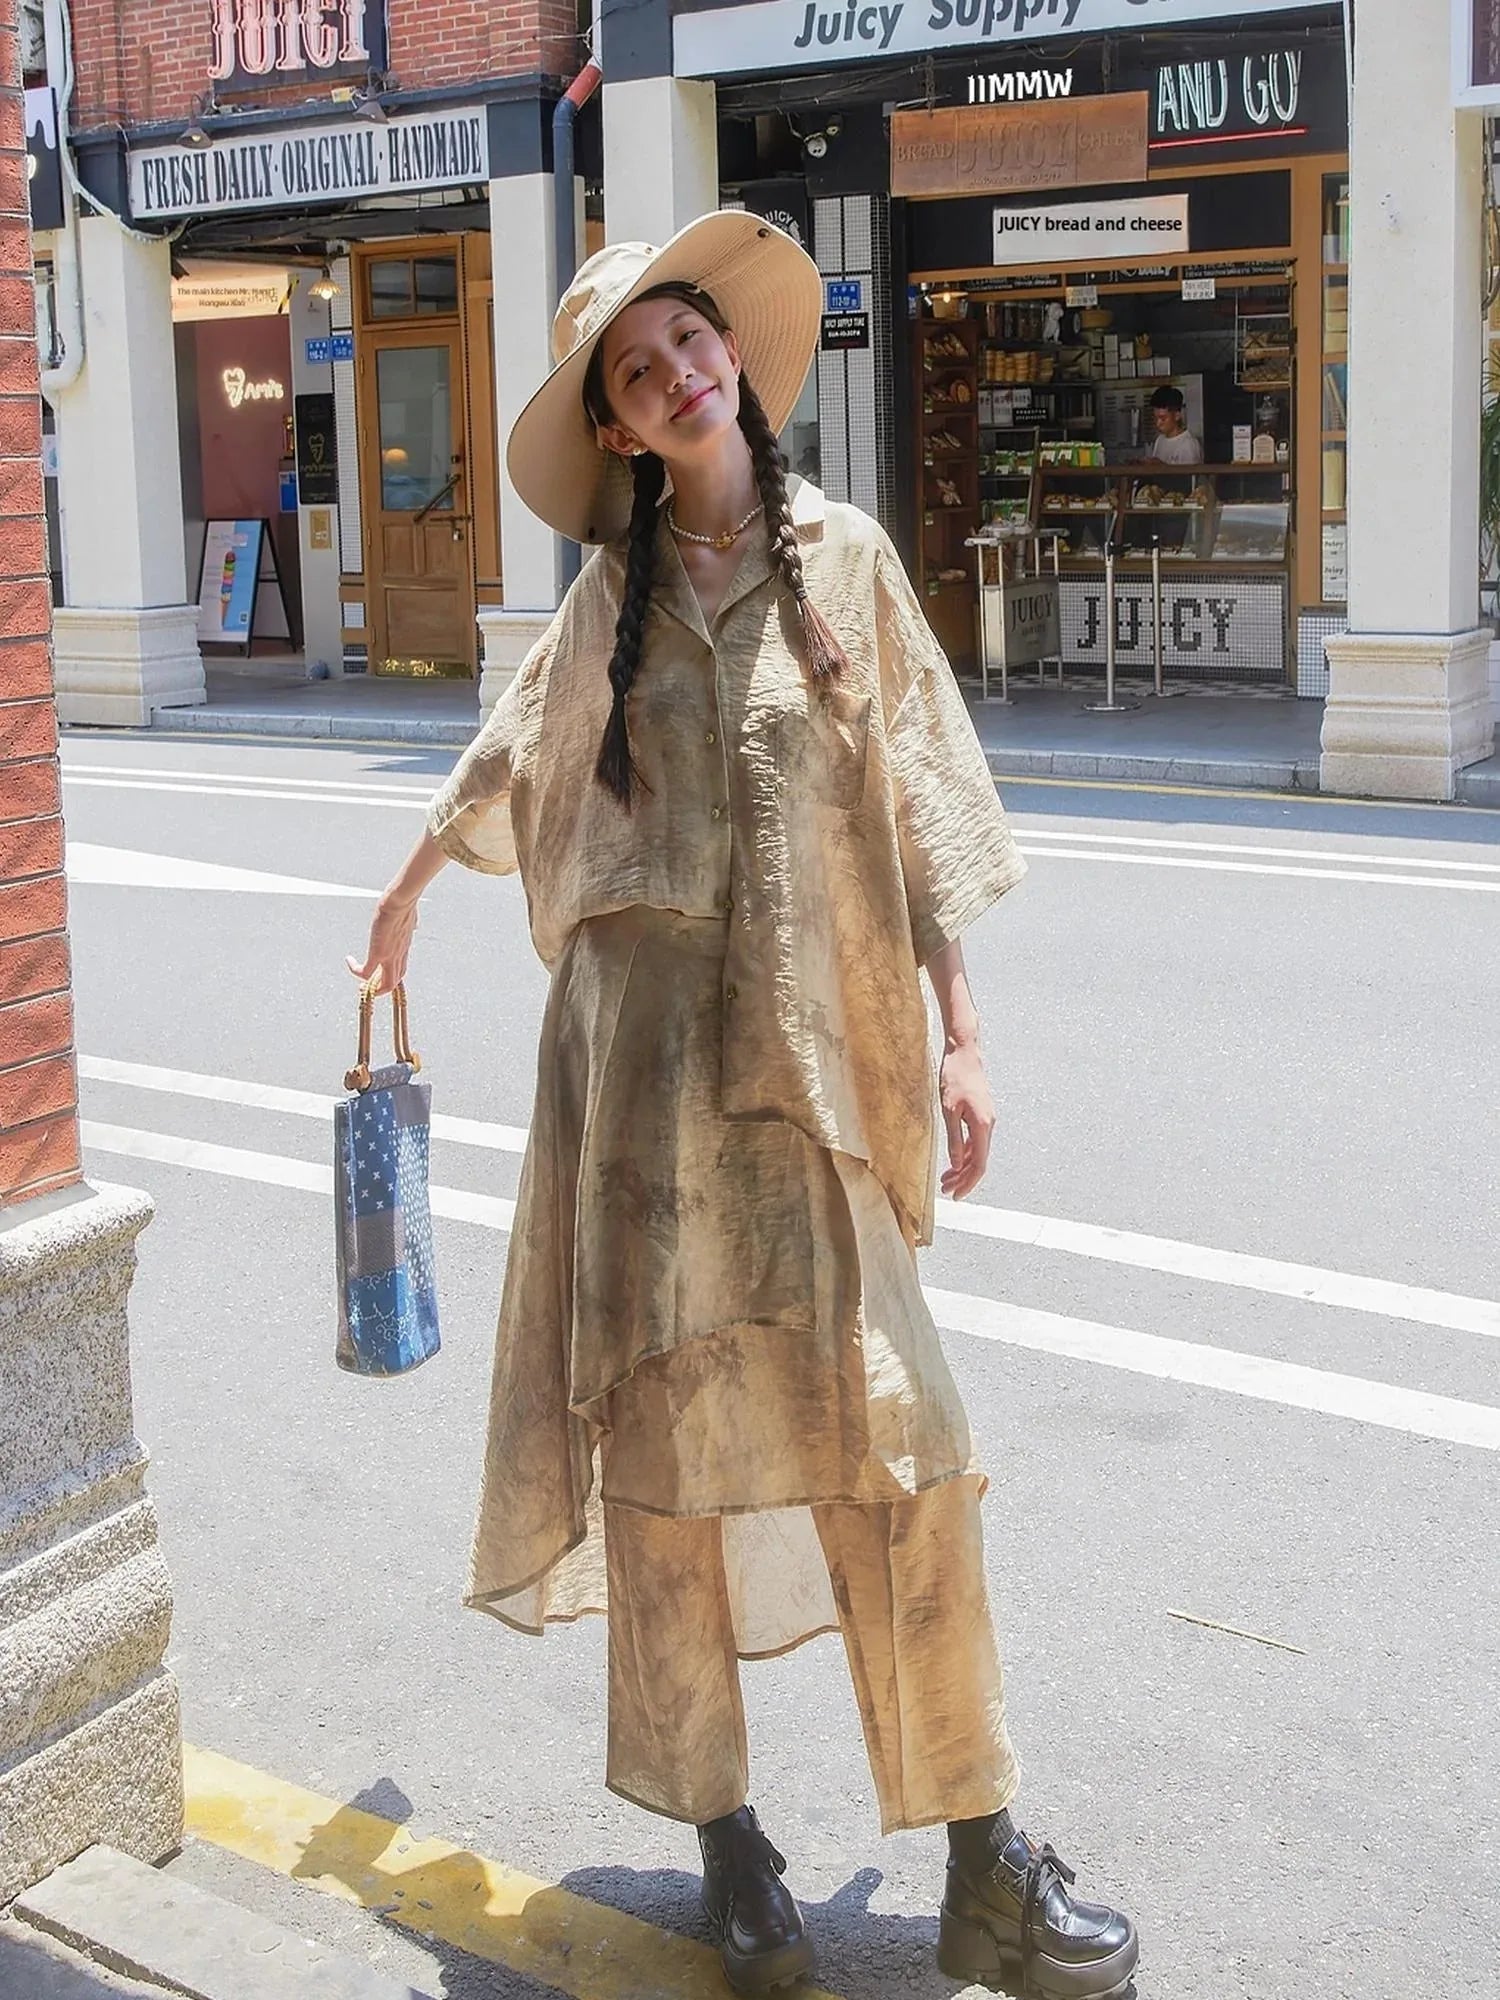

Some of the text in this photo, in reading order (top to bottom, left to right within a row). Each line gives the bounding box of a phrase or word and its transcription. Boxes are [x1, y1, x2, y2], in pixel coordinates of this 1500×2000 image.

[794, 0, 904, 49] Juicy
[142, 118, 482, 209] FRESH DAILY ORIGINAL HANDMADE
[896, 143, 953, 163] BREAD
[997, 216, 1182, 234] JUICY bread and cheese
[210, 287, 238, 295] kitchen
[1010, 591, 1054, 633] JUICY
